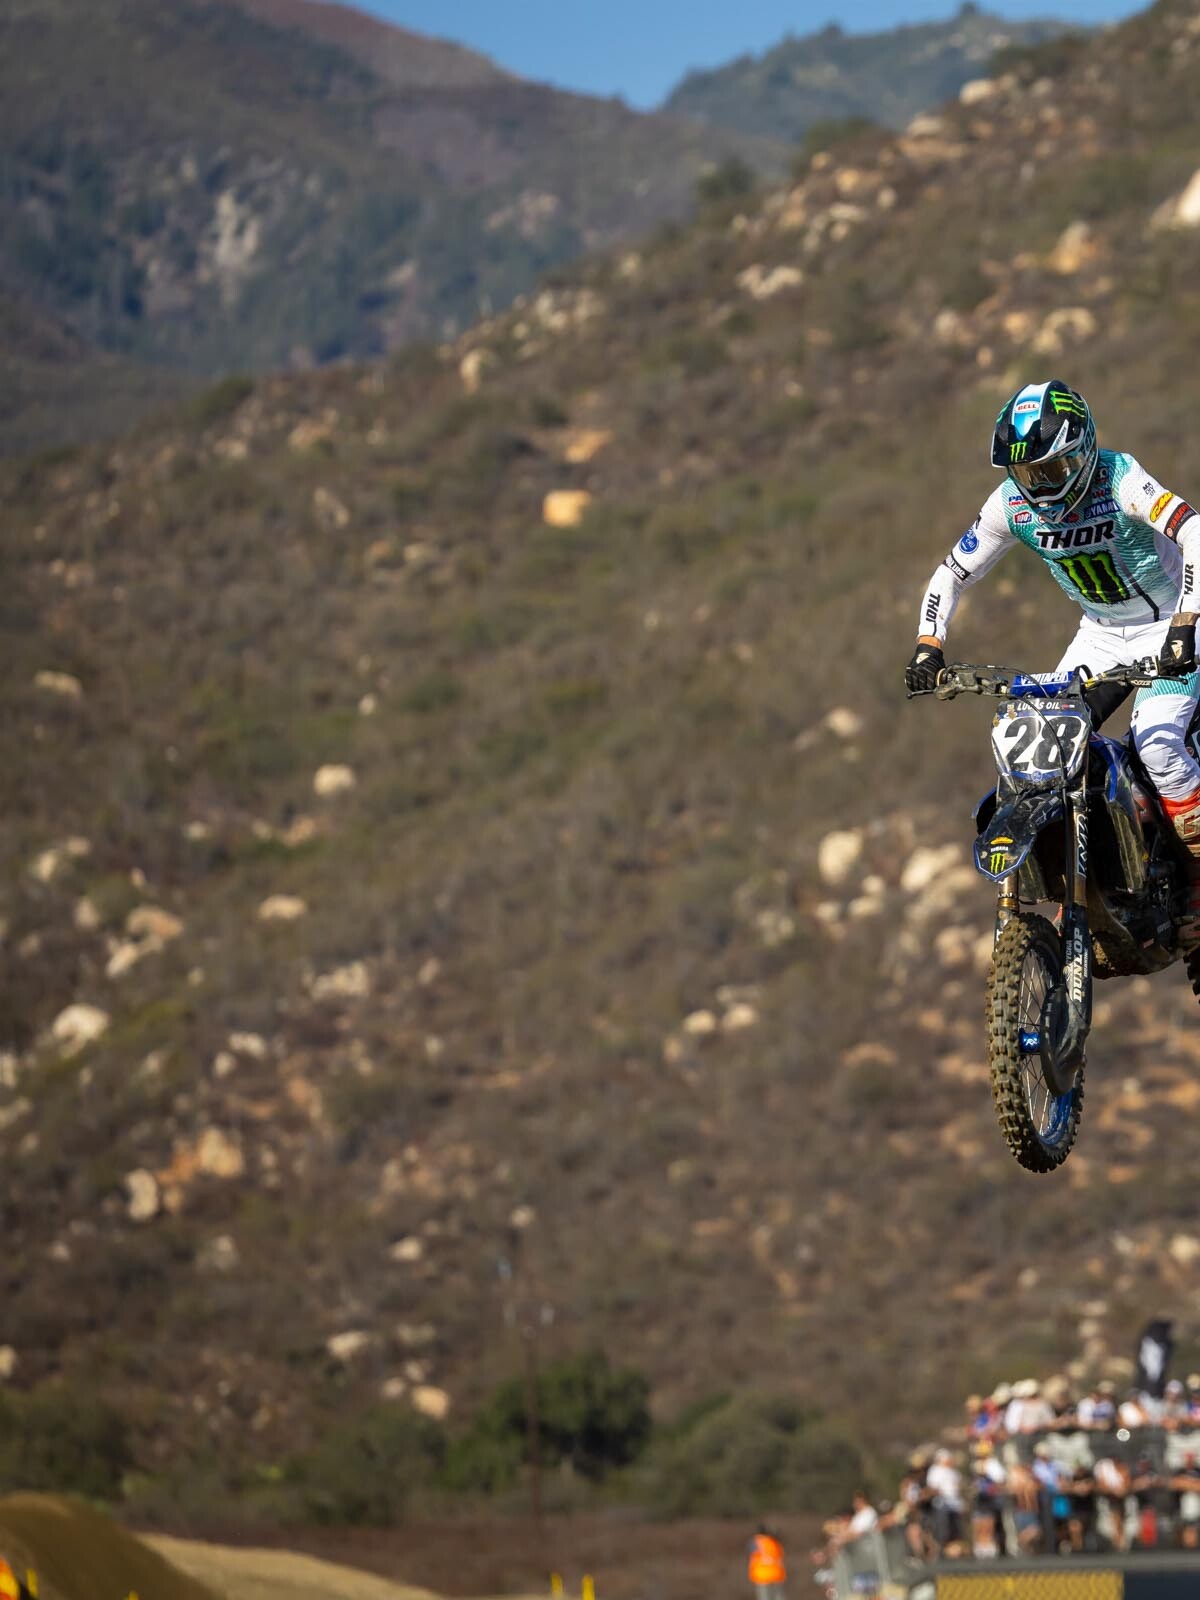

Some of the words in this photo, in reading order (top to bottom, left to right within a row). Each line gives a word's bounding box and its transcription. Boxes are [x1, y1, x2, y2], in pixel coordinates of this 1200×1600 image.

[1017, 403, 1037, 411] BELL
[1036, 520, 1116, 550] THOR
[1183, 563, 1194, 595] HOR
[1017, 701, 1044, 711] LUCAS
[1045, 701, 1060, 710] OIL
[1004, 716, 1082, 772] 28
[1073, 927, 1084, 1003] DUNLOP
